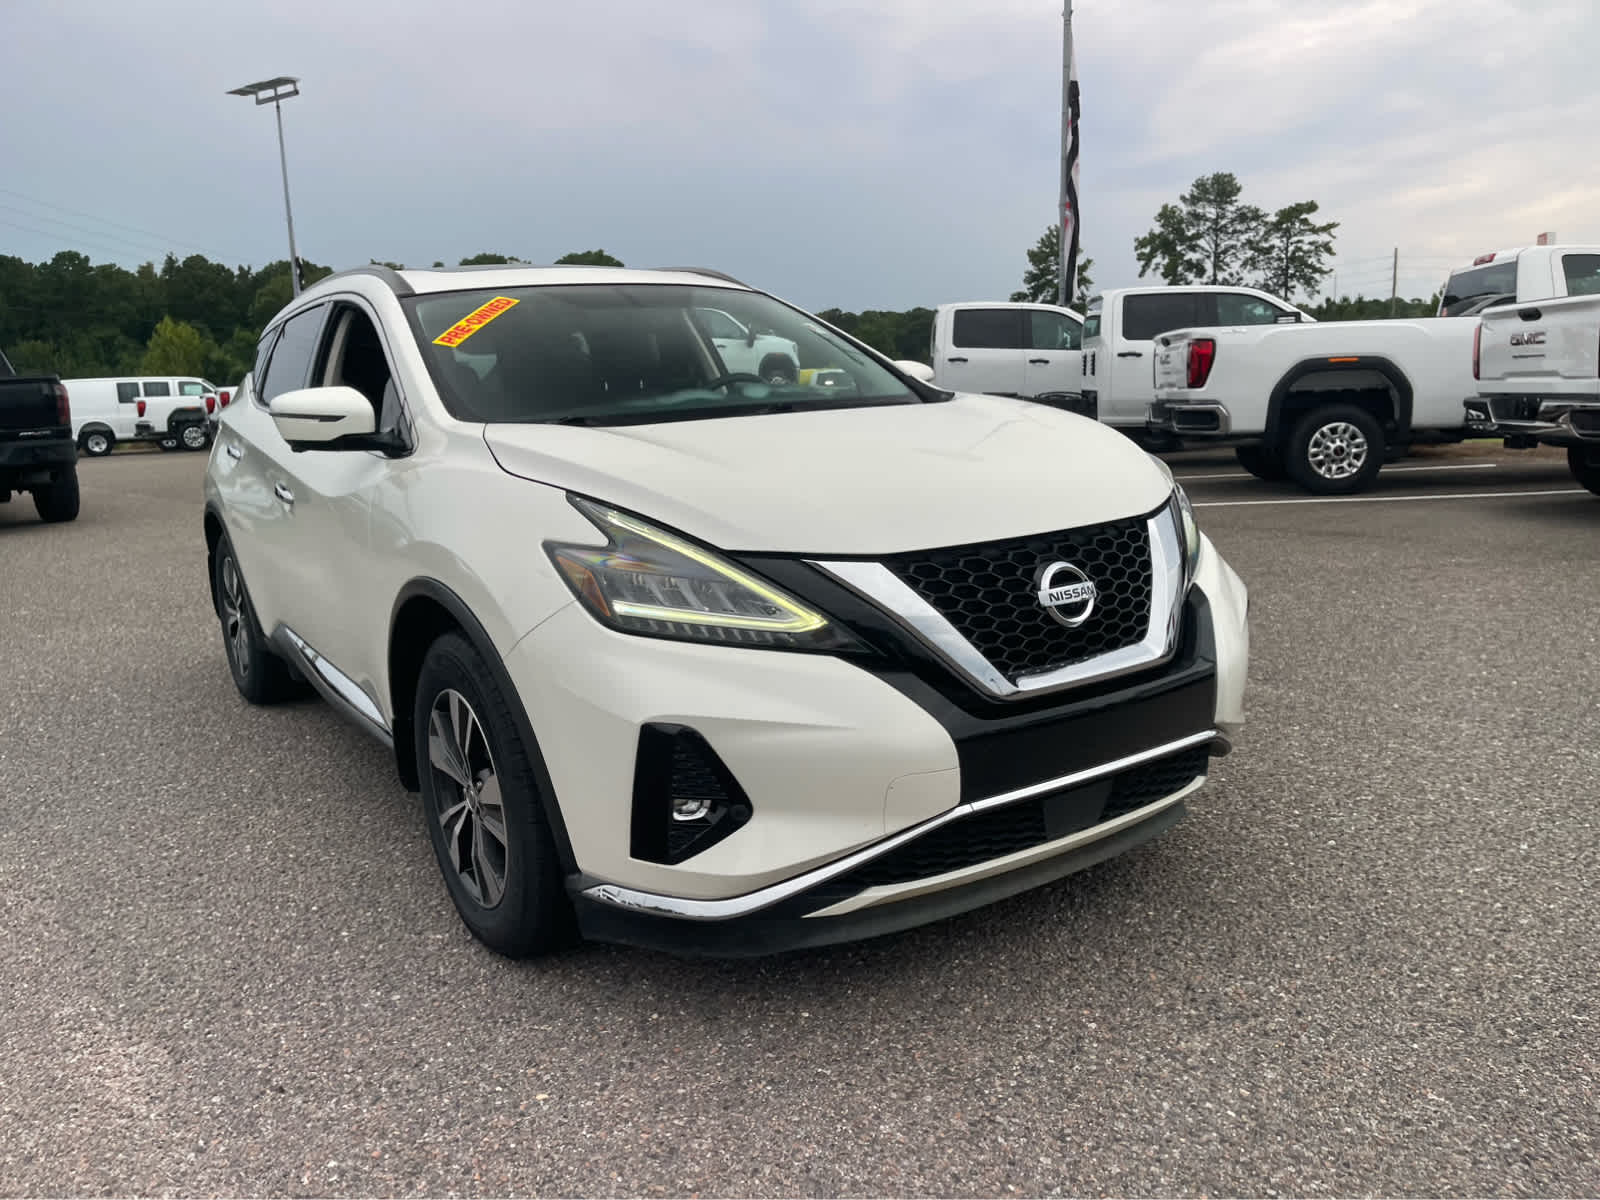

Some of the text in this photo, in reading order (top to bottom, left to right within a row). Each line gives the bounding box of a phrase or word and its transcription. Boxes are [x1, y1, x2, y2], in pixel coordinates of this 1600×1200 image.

[438, 298, 513, 345] PRE-OWNED
[1510, 331, 1546, 346] GMC
[1048, 585, 1094, 602] NISSAN
